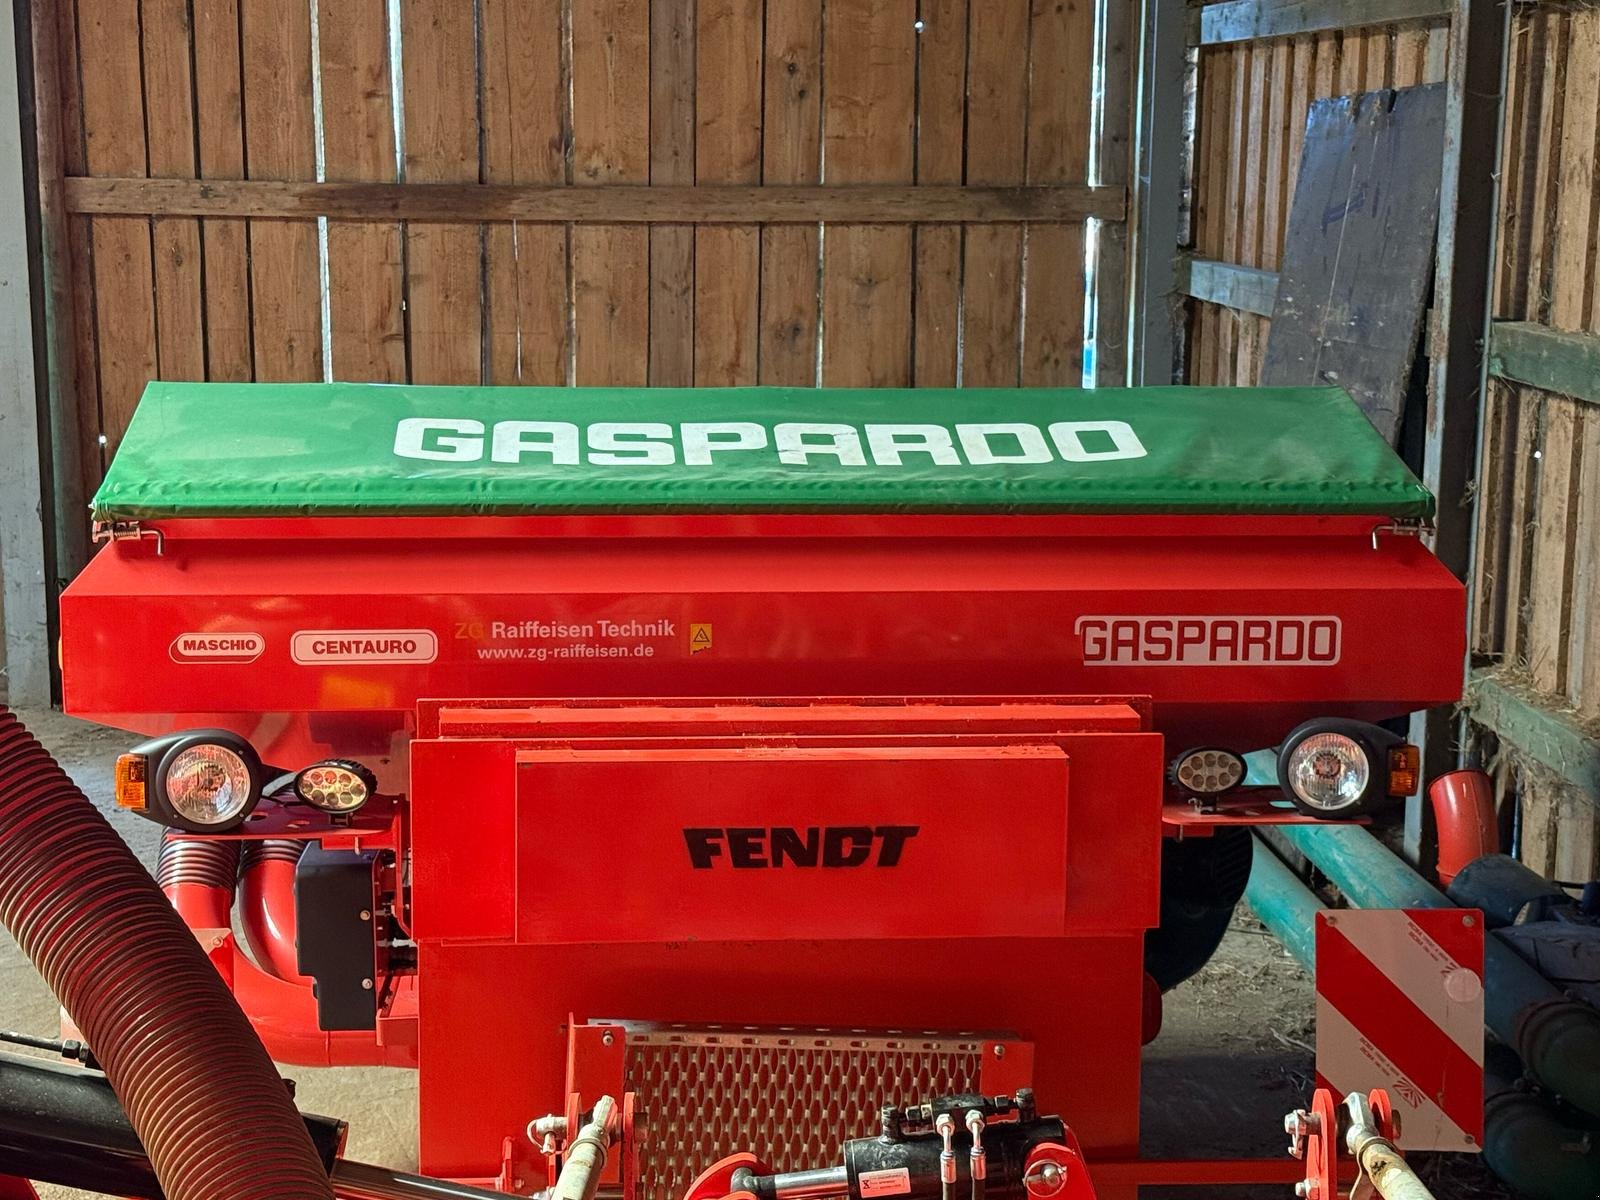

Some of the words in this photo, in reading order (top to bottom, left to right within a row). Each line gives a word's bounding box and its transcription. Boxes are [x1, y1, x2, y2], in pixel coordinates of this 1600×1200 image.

[393, 417, 1148, 467] GASPARDO
[454, 622, 485, 639] ZG
[491, 621, 593, 639] Raiffeisen
[597, 619, 675, 638] Technik
[183, 639, 257, 651] MASCHIO
[312, 639, 417, 654] CENTAURO
[1079, 619, 1338, 662] GASPARDO
[477, 643, 655, 660] www.zg-raiffeisen.de
[683, 825, 921, 869] FENDT
